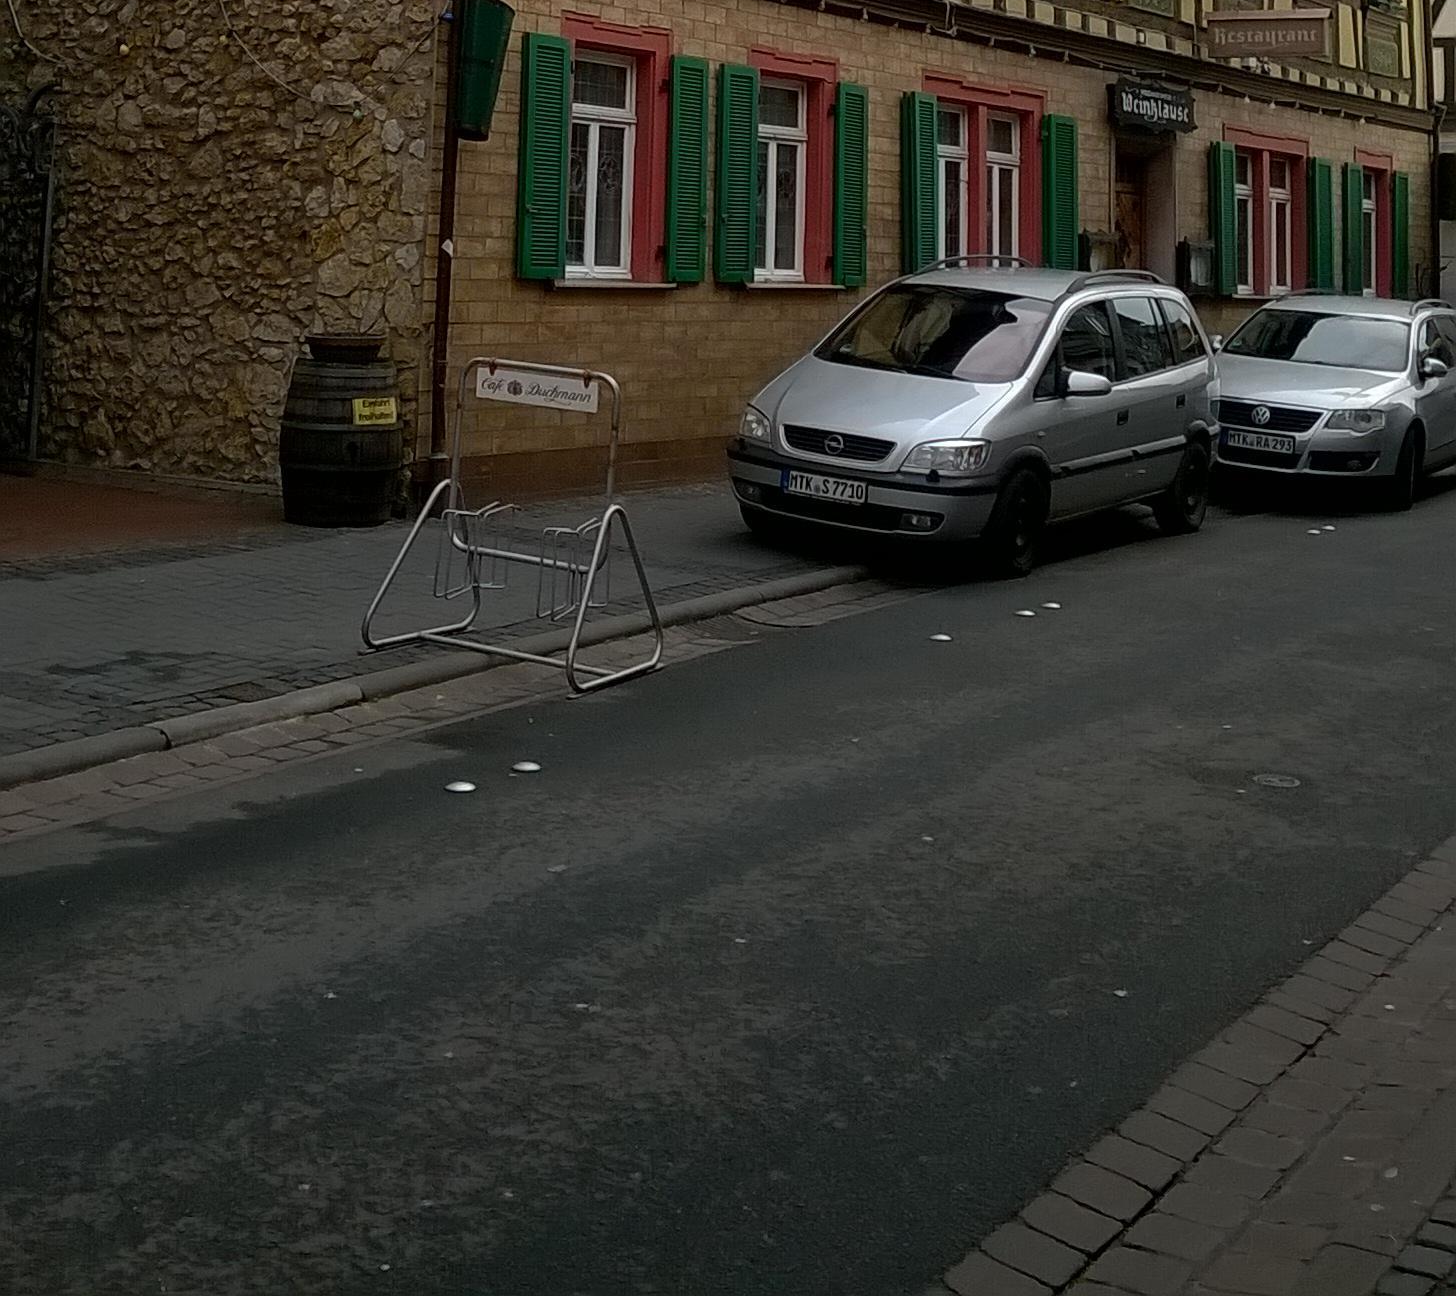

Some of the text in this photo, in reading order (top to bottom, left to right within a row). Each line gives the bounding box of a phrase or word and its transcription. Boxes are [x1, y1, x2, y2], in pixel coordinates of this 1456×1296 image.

[1214, 27, 1318, 46] Restaurant
[1121, 92, 1189, 123] Weinklause
[790, 473, 813, 492] MTK
